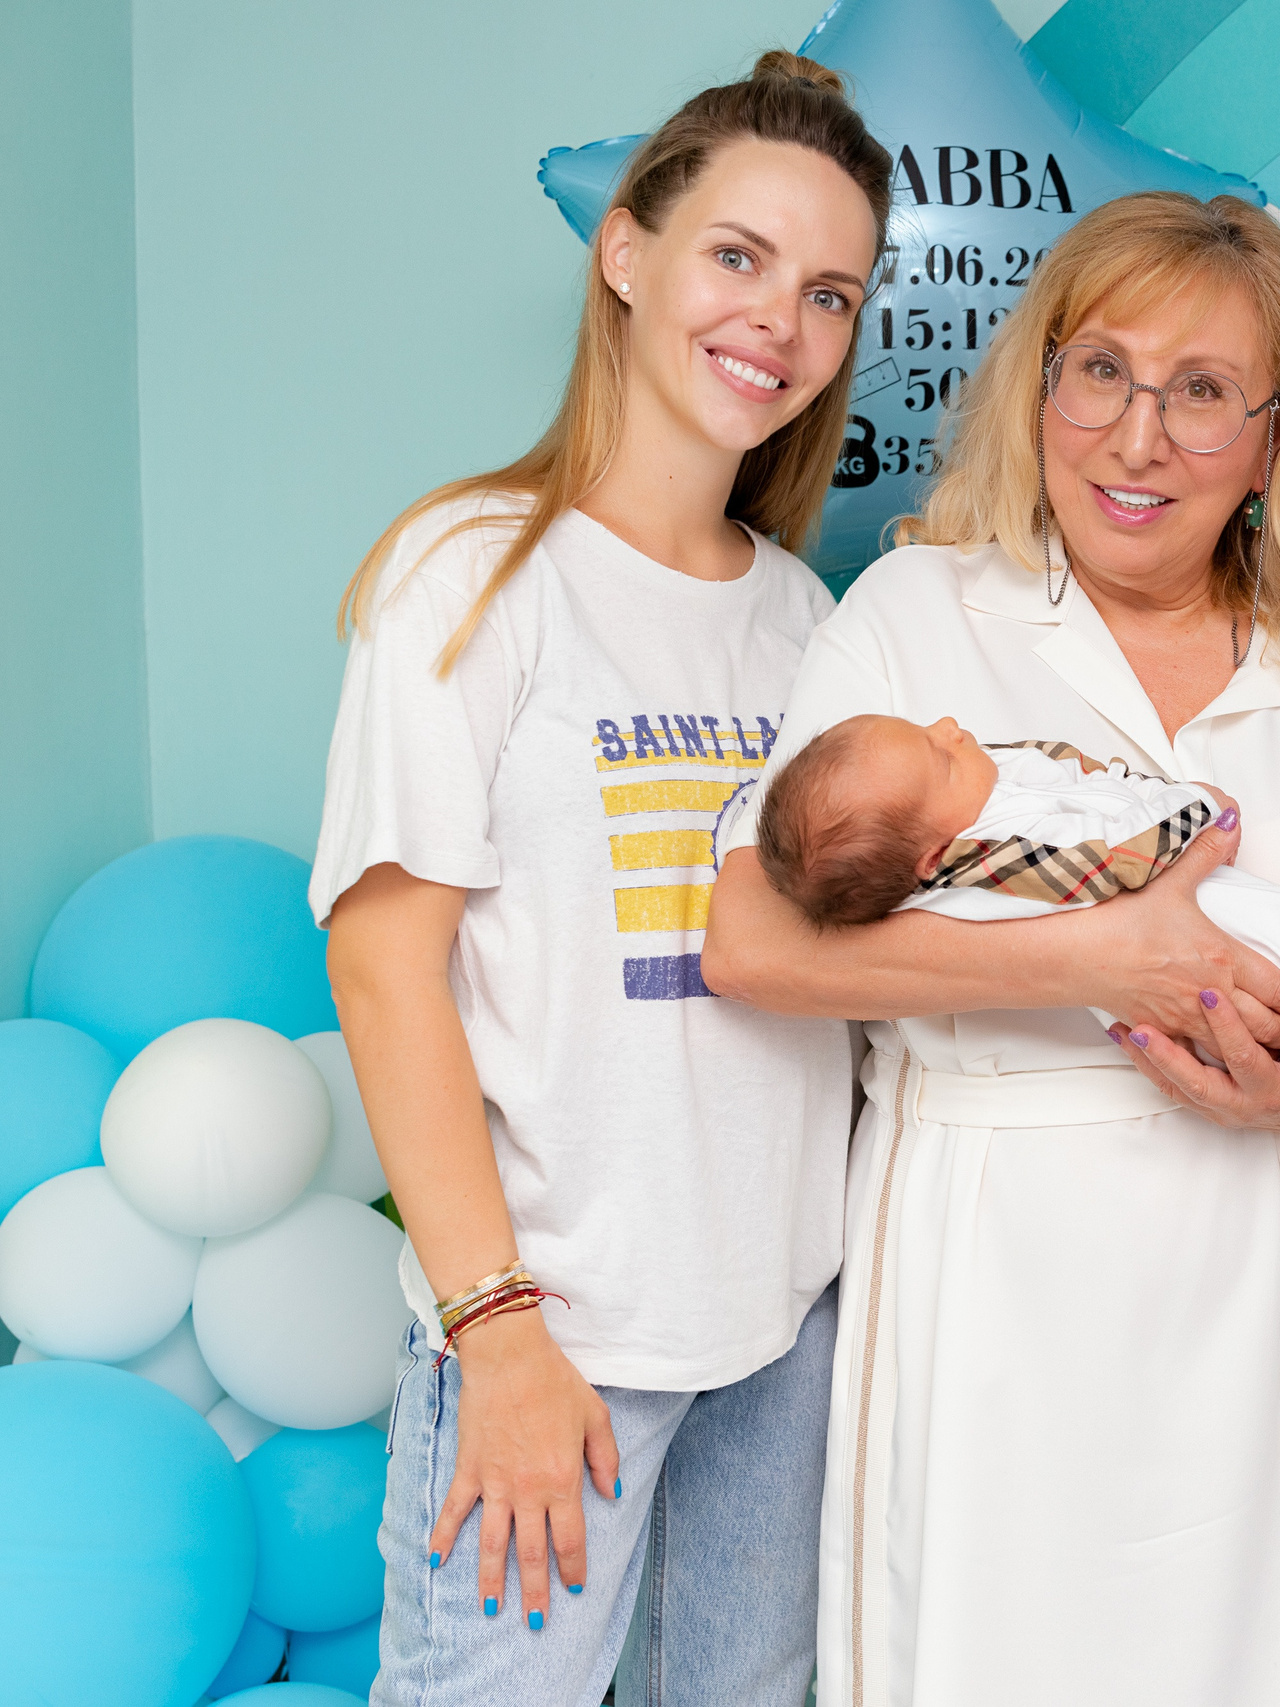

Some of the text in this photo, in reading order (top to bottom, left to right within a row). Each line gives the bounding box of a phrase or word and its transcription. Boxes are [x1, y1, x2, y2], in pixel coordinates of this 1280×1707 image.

[889, 144, 1076, 214] ABBA
[880, 243, 1052, 287] 7.06.2
[835, 456, 865, 475] KG
[596, 713, 785, 762] SAINT LA
